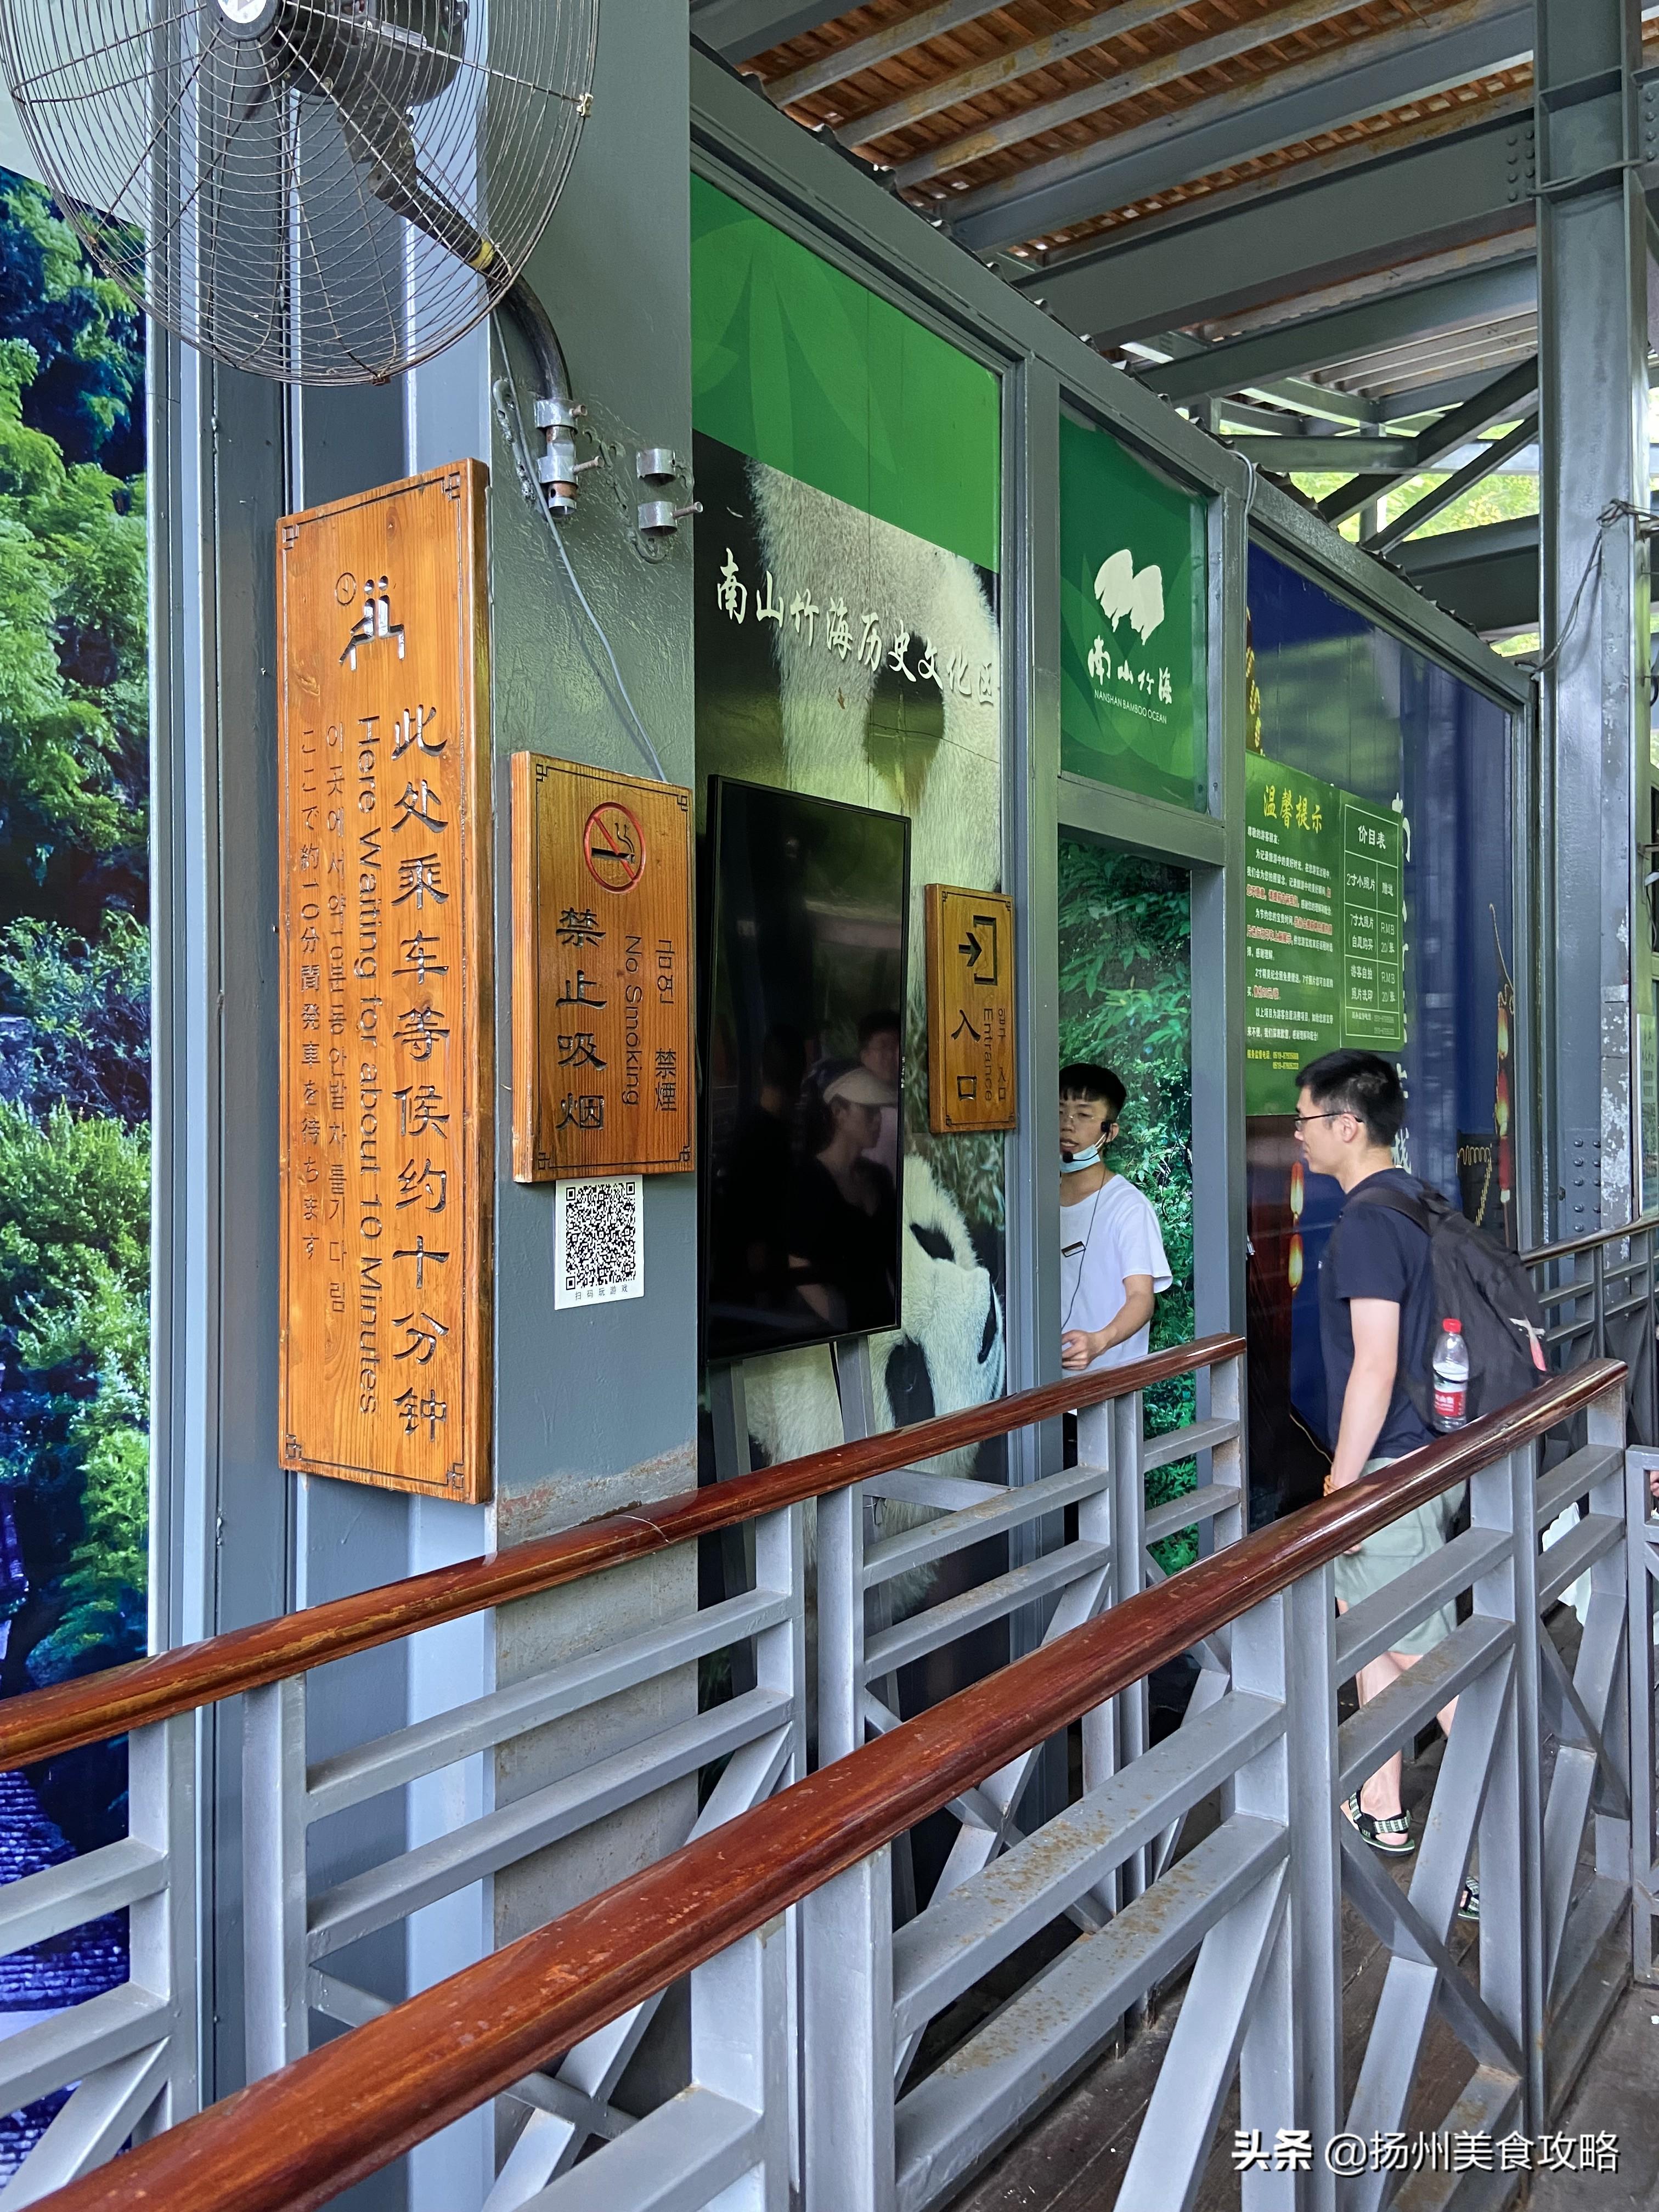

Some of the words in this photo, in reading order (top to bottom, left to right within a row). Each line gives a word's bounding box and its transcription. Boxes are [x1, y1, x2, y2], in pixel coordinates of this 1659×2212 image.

[1087, 635, 1172, 704] 南山竹海
[1094, 689, 1122, 708] NANSHAN
[1122, 698, 1148, 718] BAMBOO
[1148, 708, 1167, 724] OCEAN
[358, 715, 381, 813] Here
[1263, 784, 1323, 834] 温馨提示
[1357, 825, 1386, 850] 价目表
[354, 827, 382, 979] Waiting
[1346, 873, 1376, 891] 2寸小照片
[1350, 912, 1374, 930] 7寸大照片
[1380, 922, 1395, 935] RMB
[655, 939, 676, 1005] 금연
[1381, 971, 1396, 984] RMB
[359, 994, 383, 1047] for
[555, 906, 608, 1131] 禁止吸烟
[997, 1008, 1007, 1041] 입구
[622, 984, 643, 1107] Smoking
[951, 1009, 981, 1101] 入口
[983, 1008, 994, 1102] Entrance
[390, 704, 450, 1442] 此处乘车等候约十分钟
[997, 1066, 1007, 1102] 入口
[359, 1062, 383, 1175] about
[359, 1193, 383, 1240] 10
[575, 1283, 629, 1301] 扫码玩游戏
[359, 1257, 383, 1414] Minutes
